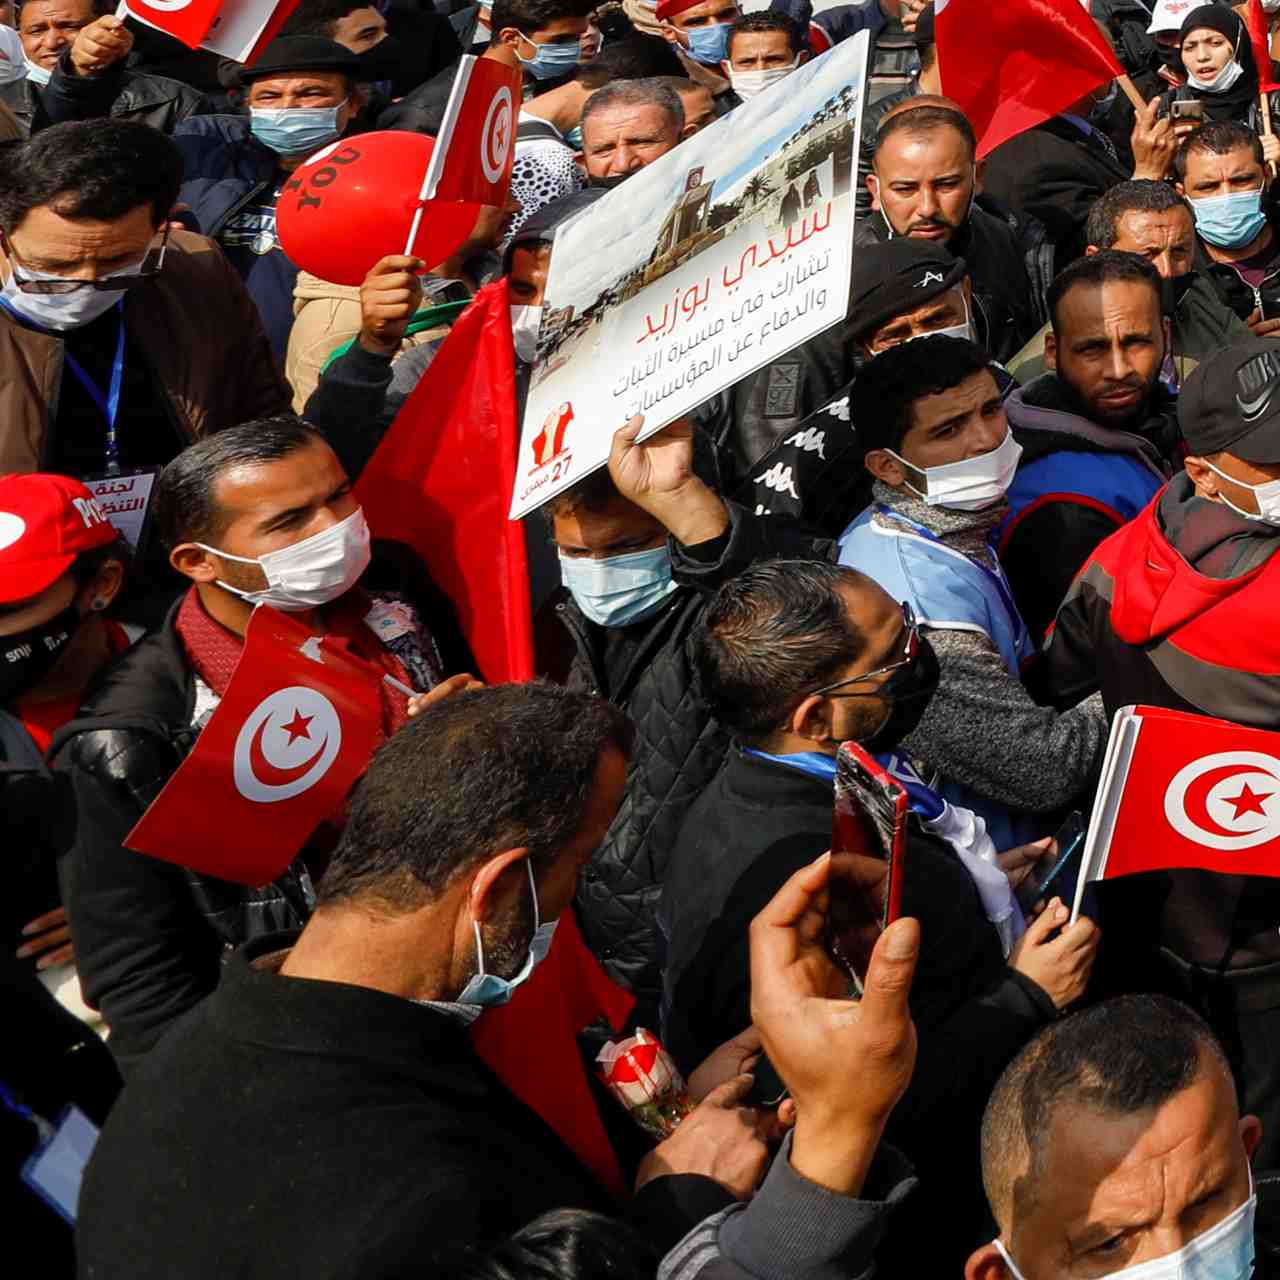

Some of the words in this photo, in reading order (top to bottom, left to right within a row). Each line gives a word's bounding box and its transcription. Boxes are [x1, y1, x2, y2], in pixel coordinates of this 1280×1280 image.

[297, 147, 361, 211] YOU
[723, 202, 832, 295] سيدي
[771, 248, 832, 299] تشارك
[637, 277, 710, 344] بوزيد
[731, 291, 764, 324] في
[760, 288, 827, 346] والدفاع
[667, 318, 725, 364] مسيرة
[728, 332, 753, 362] عن
[95, 479, 135, 496] لجنة
[551, 454, 573, 483] 27
